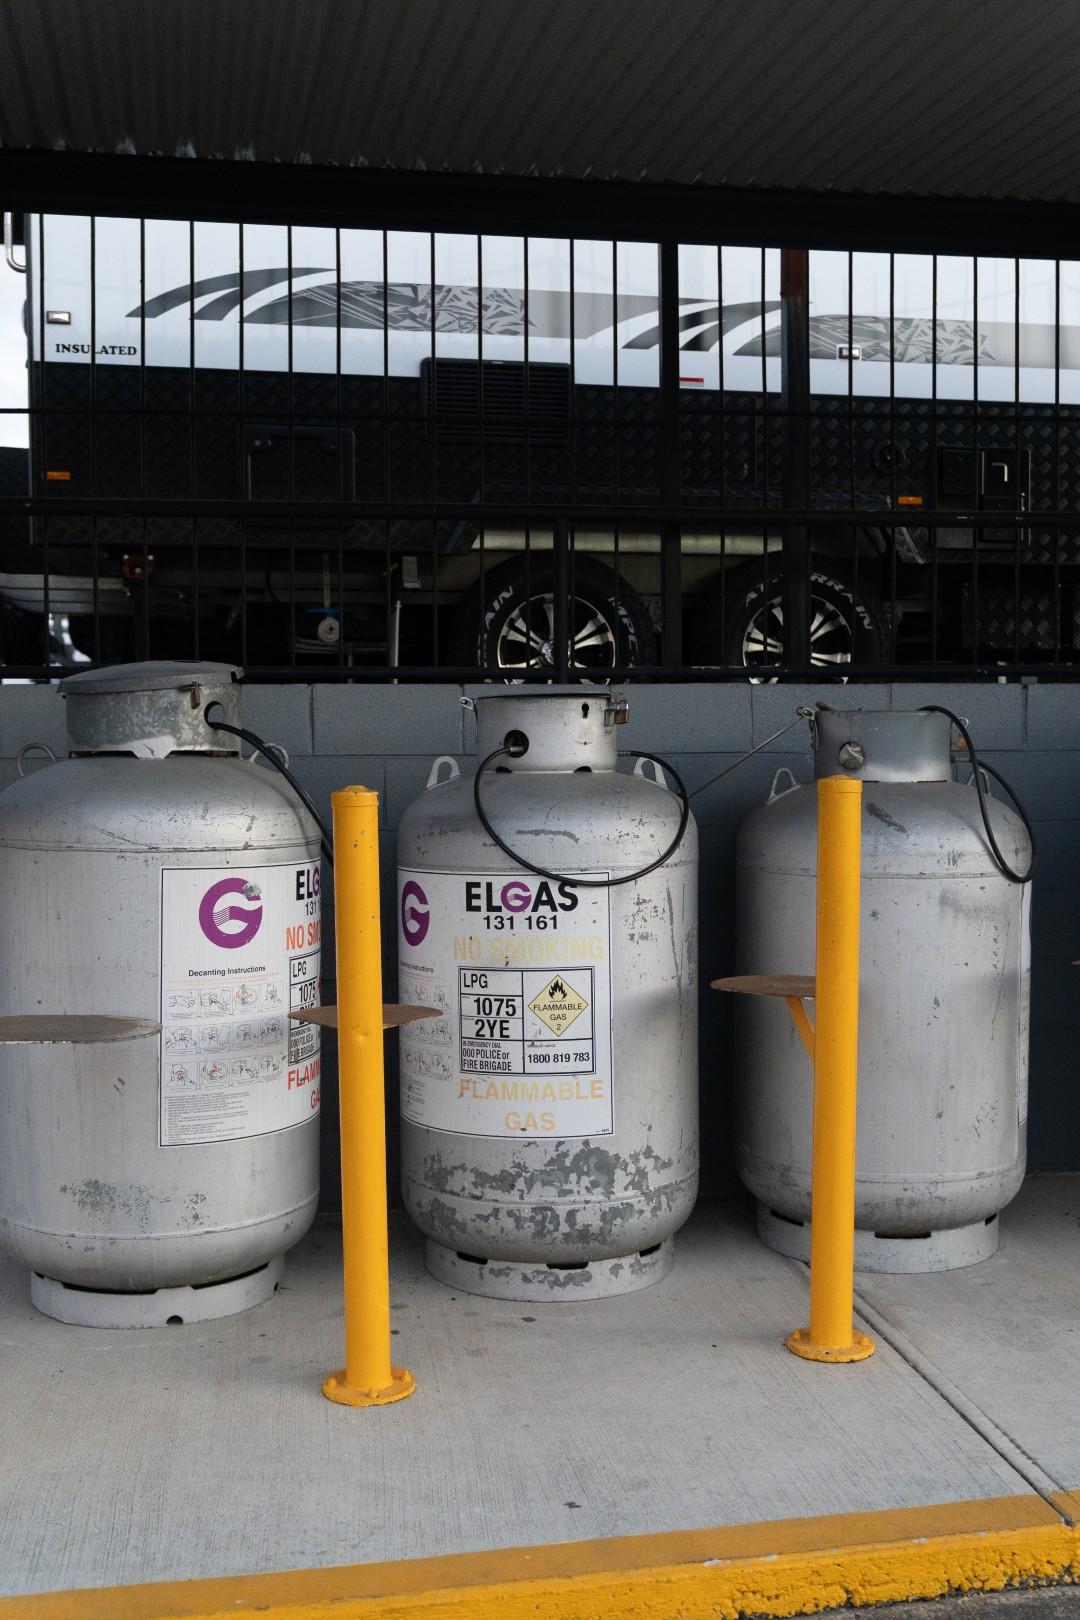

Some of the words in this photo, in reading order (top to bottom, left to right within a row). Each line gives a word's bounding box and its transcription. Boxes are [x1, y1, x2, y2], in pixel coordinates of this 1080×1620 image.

[296, 866, 321, 901] ELG
[465, 881, 579, 913] ELGAS
[483, 915, 514, 930] 131
[525, 915, 558, 930] 161
[286, 924, 305, 951] NO
[454, 936, 482, 961] NO
[489, 935, 605, 962] SMOKING
[188, 968, 226, 977] Decanting
[227, 965, 266, 975] Instructions
[292, 960, 307, 978] LPG
[463, 973, 488, 989] LPG
[298, 980, 316, 1003] 1075
[473, 996, 517, 1017] 1075
[533, 1002, 583, 1012] FLAMMABLE
[549, 1013, 567, 1021] GAS
[474, 1018, 510, 1039] 2YE
[556, 1023, 562, 1031] 2
[462, 1047, 475, 1058] 000
[475, 1048, 501, 1060] POLICE
[502, 1052, 510, 1060] or
[527, 1053, 551, 1064] 1800
[553, 1052, 571, 1063] 819
[573, 1051, 590, 1062] 783
[463, 1059, 478, 1070] FIRE
[479, 1060, 512, 1071] BRIGADE
[458, 1078, 605, 1101] FLAMMABLE
[504, 1111, 556, 1132] GAS
